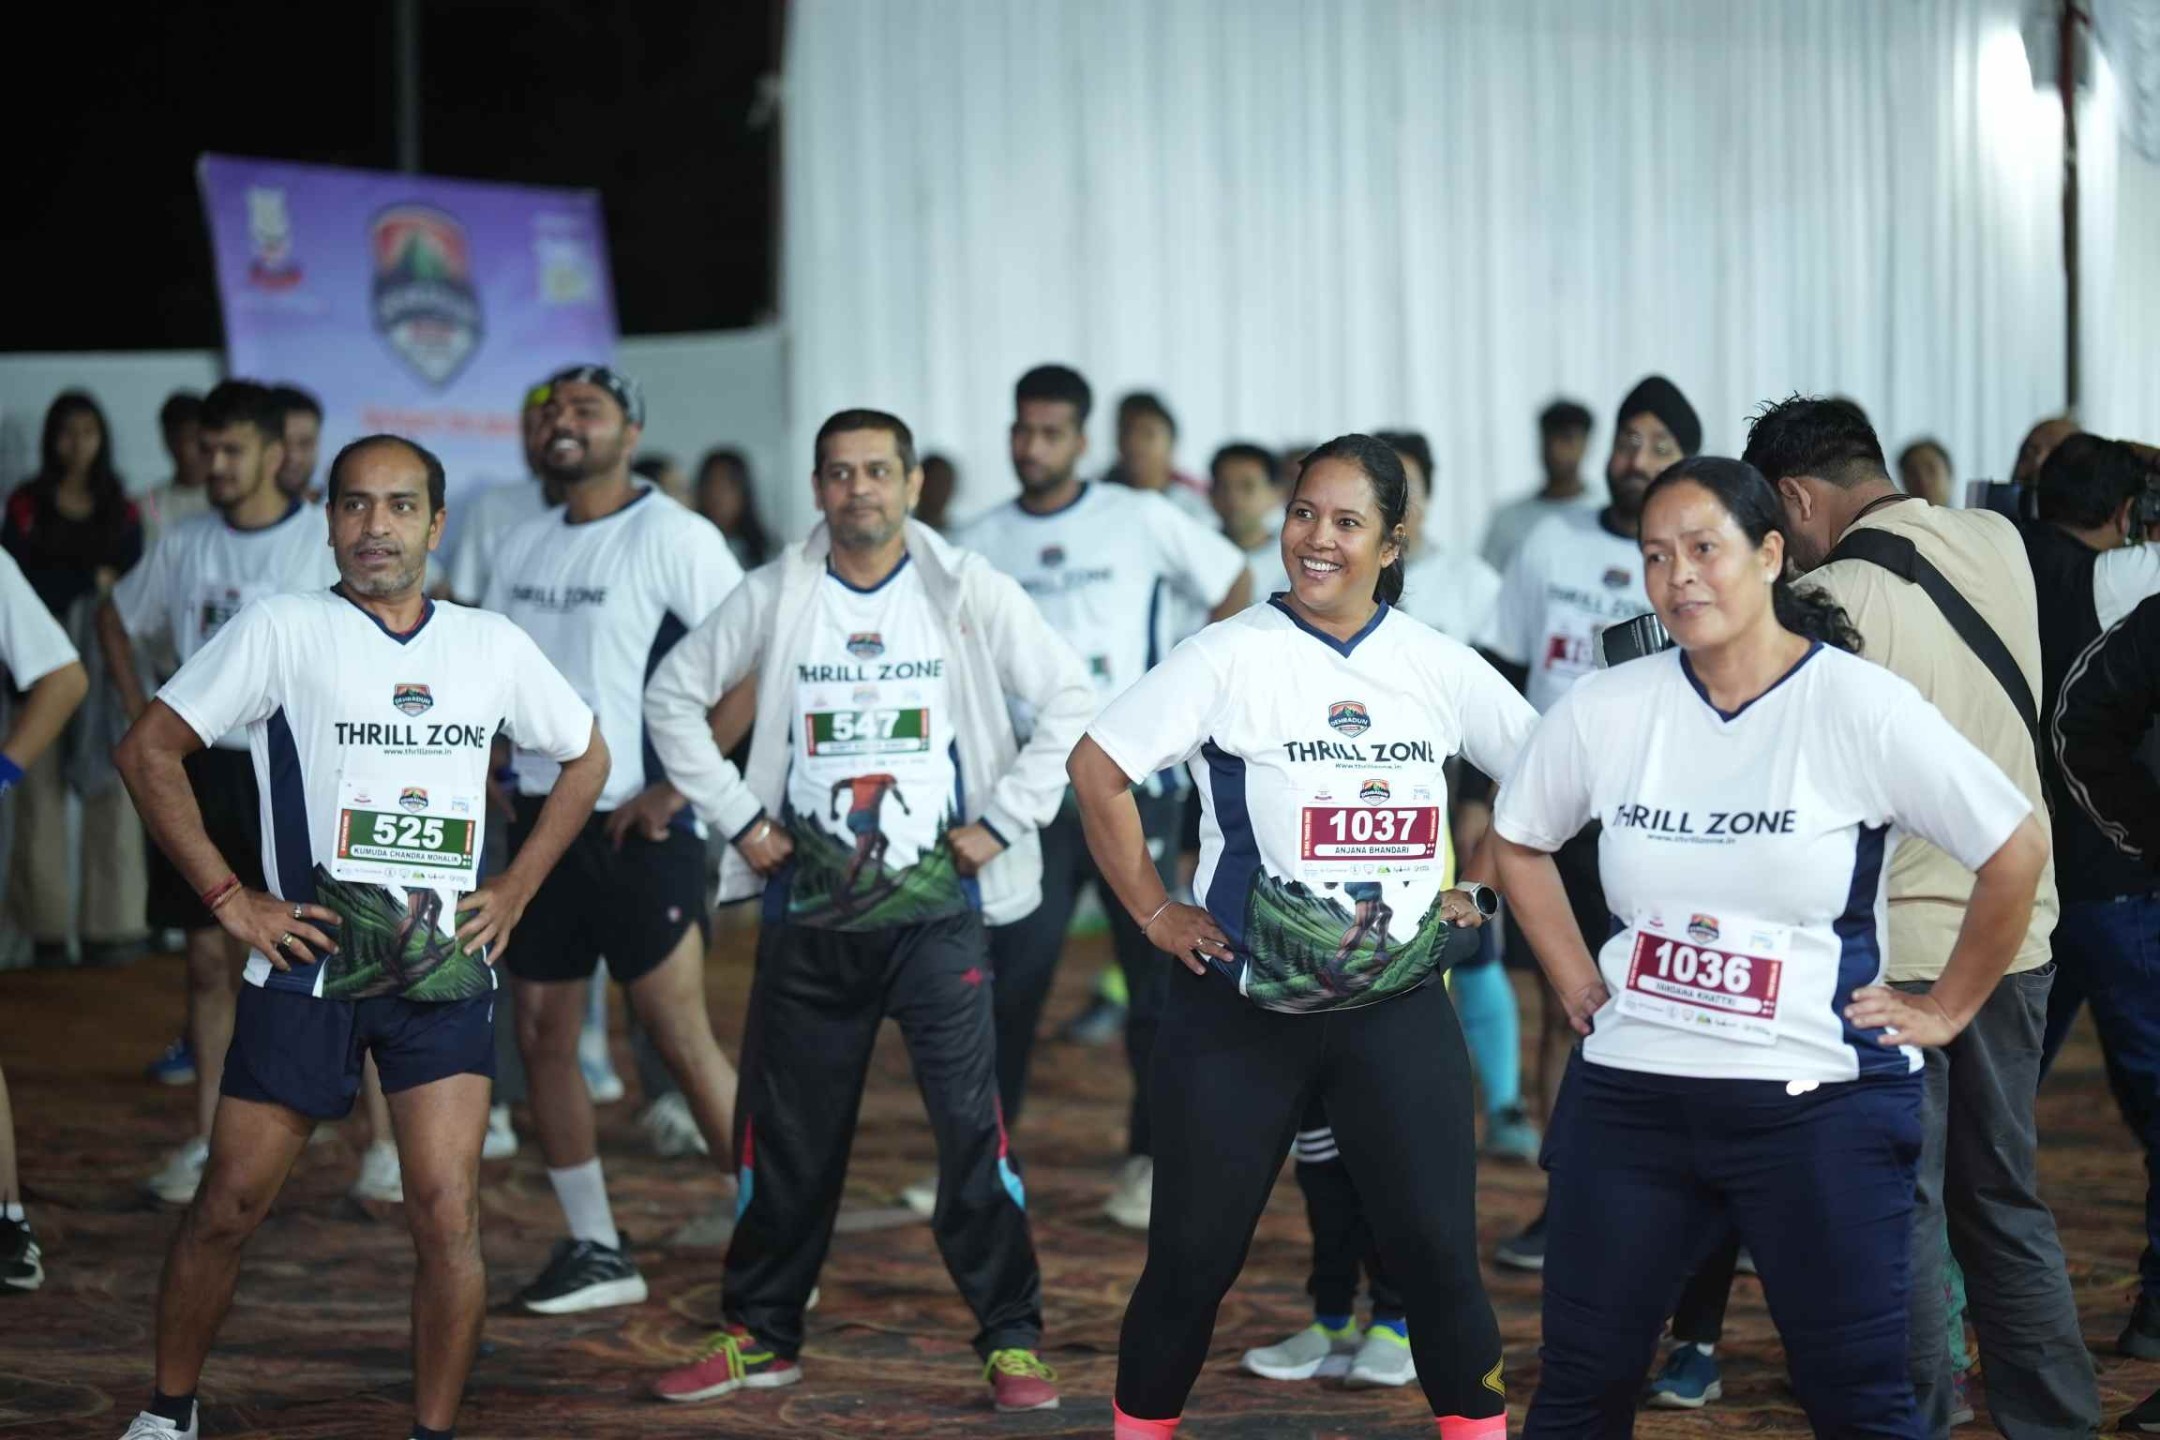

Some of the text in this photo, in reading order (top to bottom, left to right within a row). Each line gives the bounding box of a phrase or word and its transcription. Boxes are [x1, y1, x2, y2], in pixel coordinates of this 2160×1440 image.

[878, 658, 944, 681] ZONE
[335, 723, 486, 748] THRILL ZONE
[831, 710, 900, 741] 547
[383, 748, 452, 756] www.thrillzone.in
[1283, 739, 1367, 762] THRILL
[372, 813, 445, 850] 525
[1329, 810, 1418, 842] 1037
[1705, 810, 1796, 835] ZONE
[353, 847, 459, 863] KUMUDA CHANDRA MOHALIK
[1335, 846, 1409, 854] ANJANA BHANDARI
[1655, 940, 1752, 994] 1036
